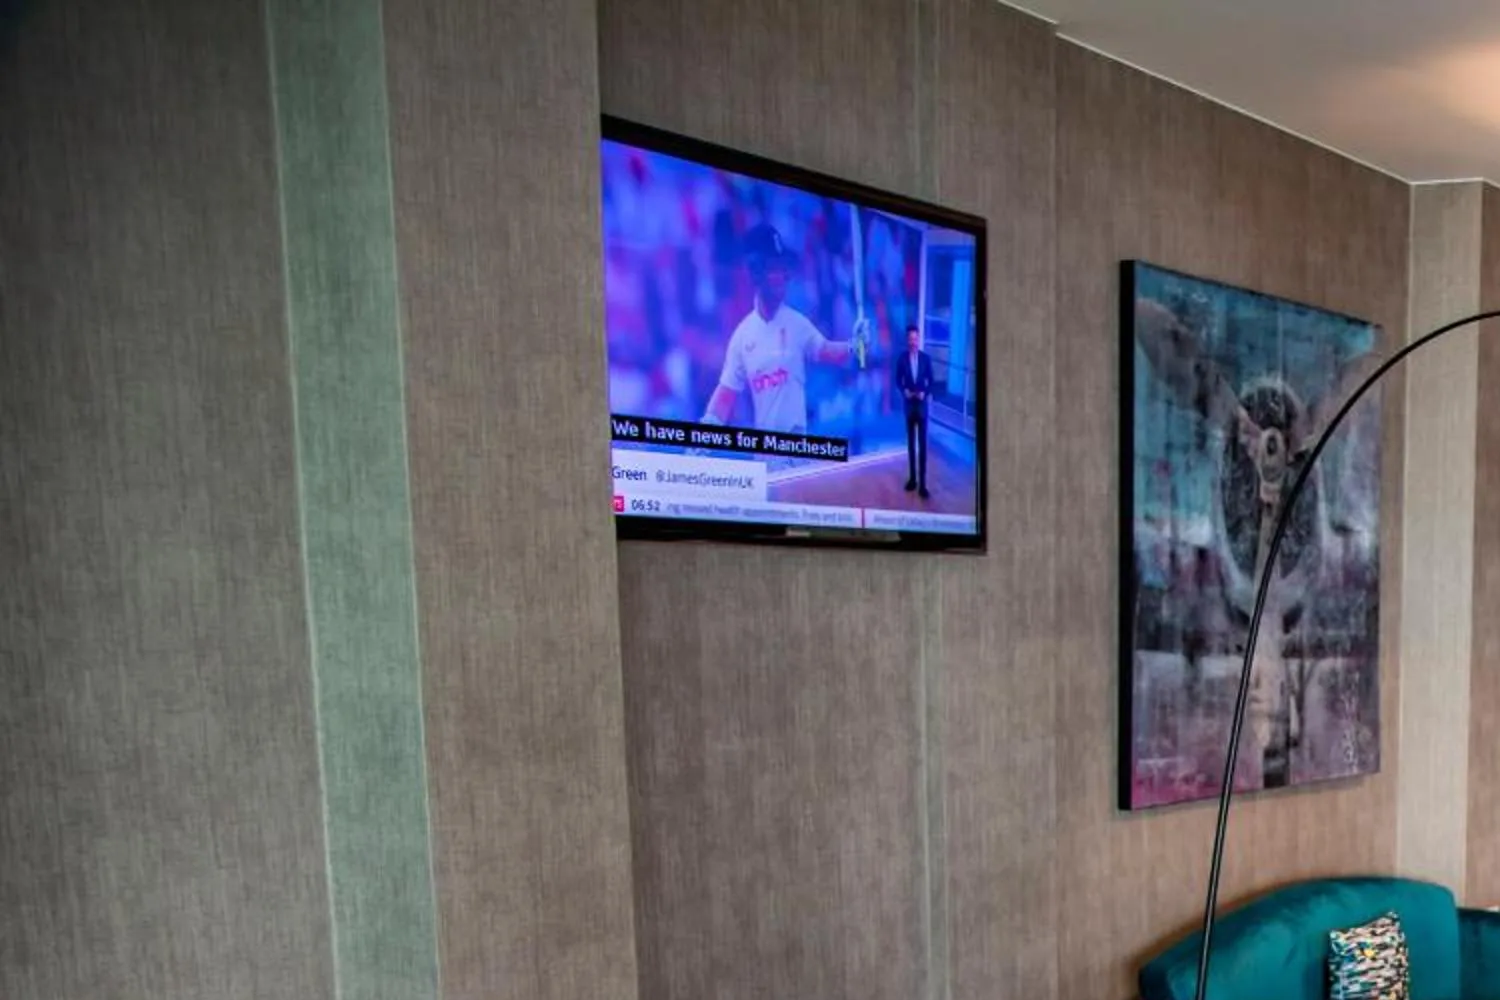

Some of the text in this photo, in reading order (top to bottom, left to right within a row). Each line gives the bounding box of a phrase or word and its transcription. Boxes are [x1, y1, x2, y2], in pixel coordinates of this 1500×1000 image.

[611, 419, 847, 457] We have news for Manchester
[611, 465, 647, 481] Green
